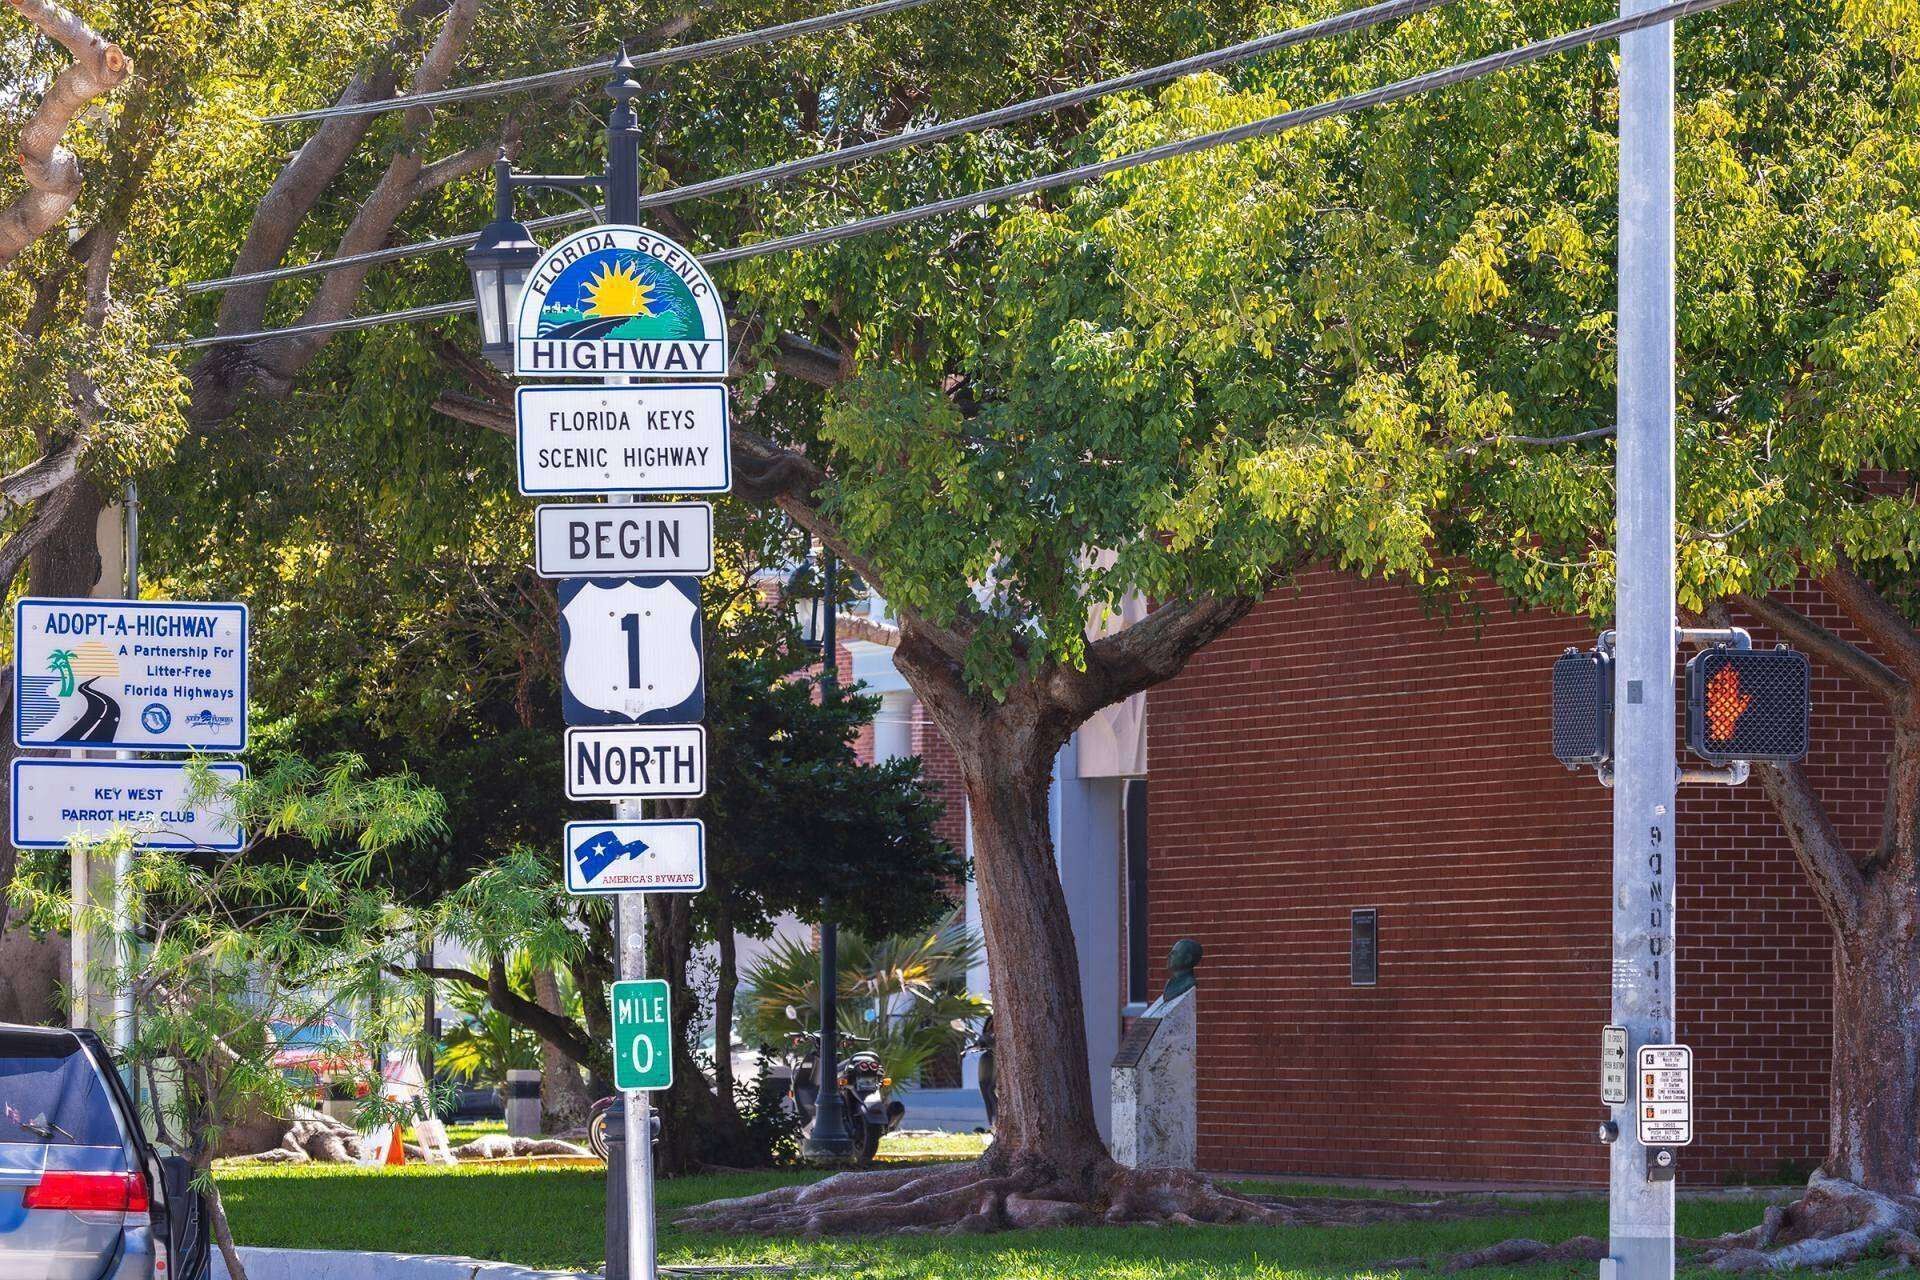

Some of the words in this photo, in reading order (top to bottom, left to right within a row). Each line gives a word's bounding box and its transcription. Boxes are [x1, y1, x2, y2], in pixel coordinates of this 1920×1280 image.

[532, 233, 616, 297] FLORIDA
[636, 236, 708, 298] SCENIC
[533, 341, 710, 370] HIGHWAY
[550, 411, 630, 431] FLORIDA
[647, 410, 695, 430] KEYS
[539, 448, 608, 468] SCENIC
[624, 447, 709, 467] HIGHWAY
[569, 520, 680, 560] BEGIN
[45, 612, 218, 637] ADOPT-A-HIGHWAY
[118, 645, 128, 656] A
[134, 645, 207, 660] Partnership
[214, 646, 234, 658] For
[621, 613, 641, 689] 1
[147, 665, 212, 678] Litter-Free
[124, 685, 168, 697] Florida
[174, 685, 234, 700] Highways
[577, 741, 695, 786] NORTH
[95, 788, 122, 800] KEY
[128, 788, 163, 800] WEST
[62, 809, 114, 822] PARROT
[161, 811, 195, 823] CLUB
[603, 875, 653, 884] AMERICA'S
[655, 873, 694, 883] BYWAYS
[618, 997, 665, 1024] MILE
[632, 1034, 654, 1073] 0
